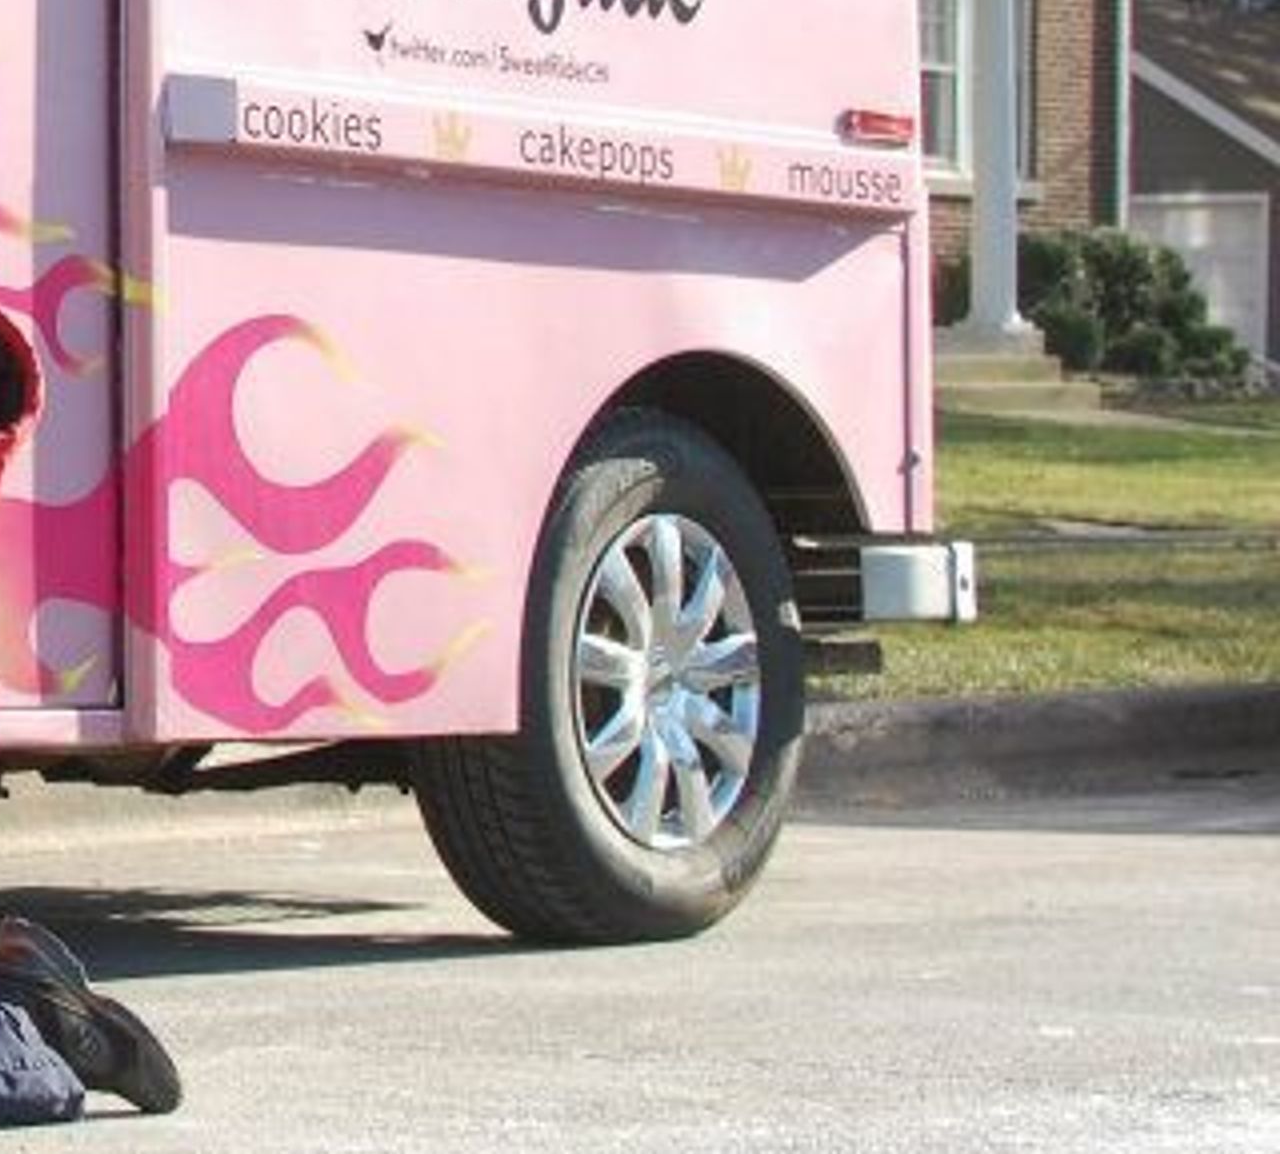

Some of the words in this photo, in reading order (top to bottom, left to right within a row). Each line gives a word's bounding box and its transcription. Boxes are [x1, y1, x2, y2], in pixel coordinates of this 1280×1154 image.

[243, 101, 383, 149] cookies
[519, 124, 674, 180] cakepops
[787, 160, 902, 203] mousse
